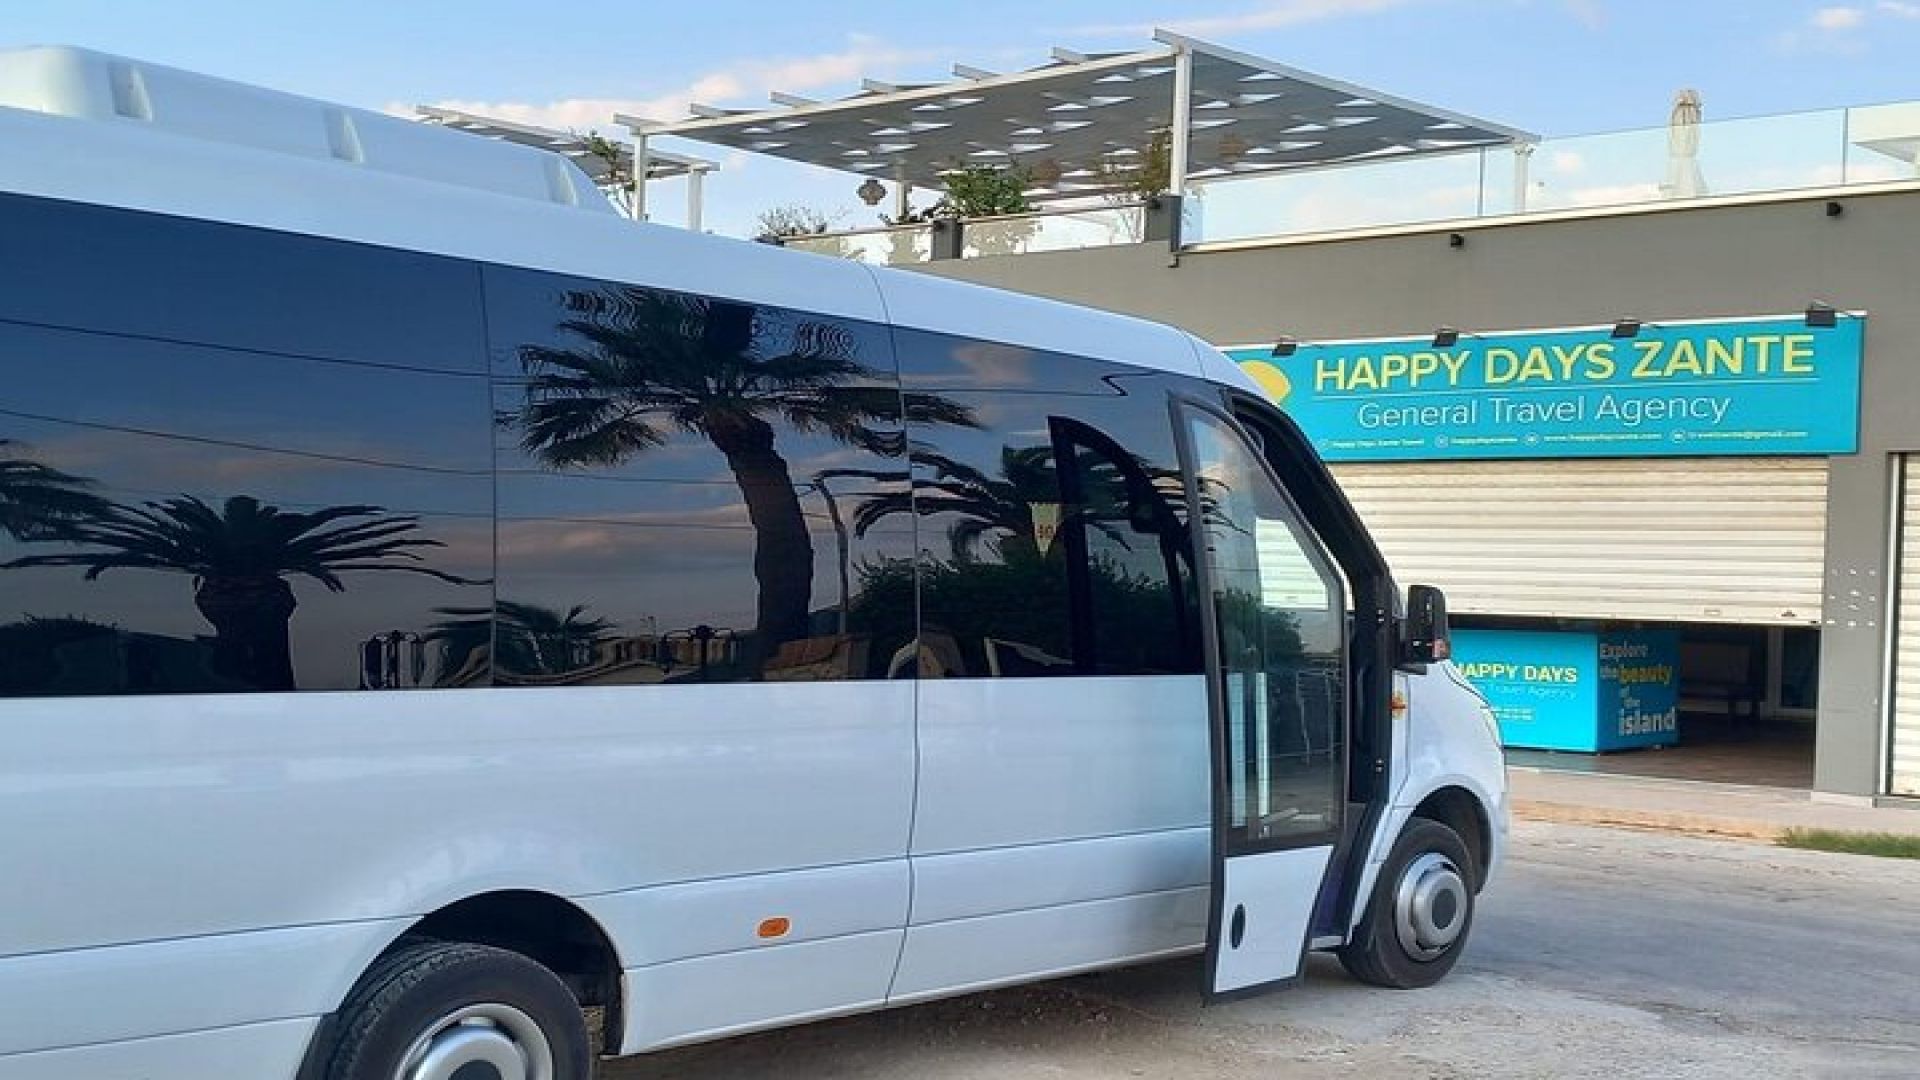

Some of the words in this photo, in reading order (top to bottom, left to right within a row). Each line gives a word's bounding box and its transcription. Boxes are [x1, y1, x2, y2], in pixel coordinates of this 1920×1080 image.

[1315, 351, 1472, 392] HAPPY
[1485, 343, 1616, 384] DAYS
[1631, 334, 1815, 377] ZANTE
[1358, 399, 1478, 428] General
[1489, 395, 1585, 424] Travel
[1594, 394, 1732, 426] Agency
[1524, 665, 1578, 682] DAYS
[1618, 664, 1672, 686] beauty
[1619, 706, 1677, 736] island
